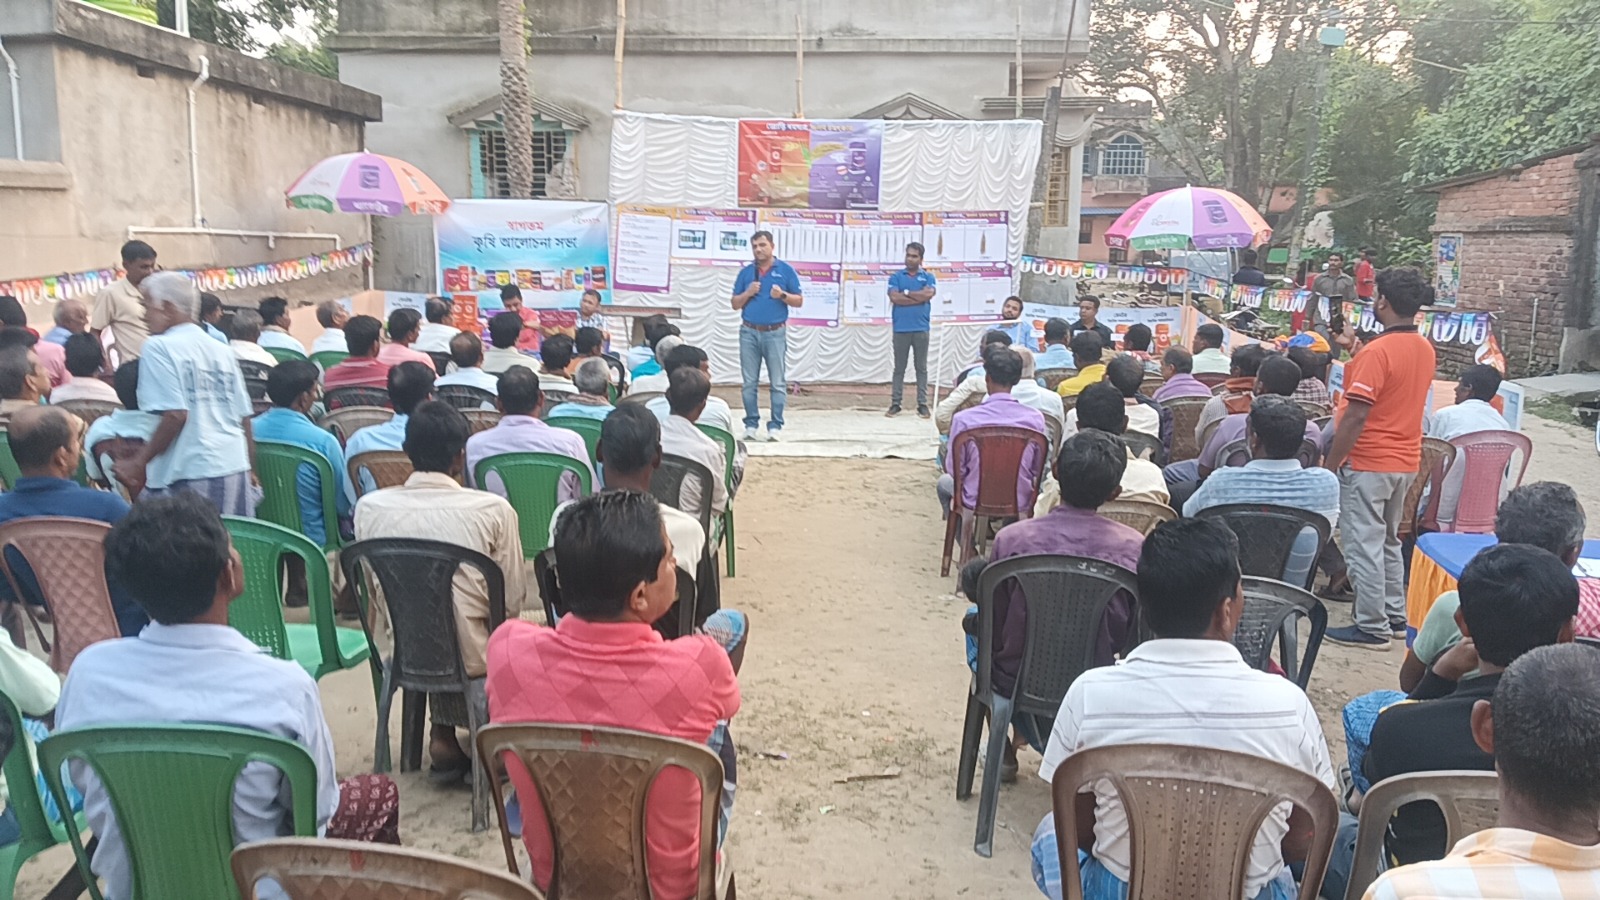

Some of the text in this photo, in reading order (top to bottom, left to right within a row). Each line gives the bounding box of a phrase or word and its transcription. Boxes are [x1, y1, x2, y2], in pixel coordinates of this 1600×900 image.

[472, 232, 577, 254] কৃষি আলোচনা সভা
